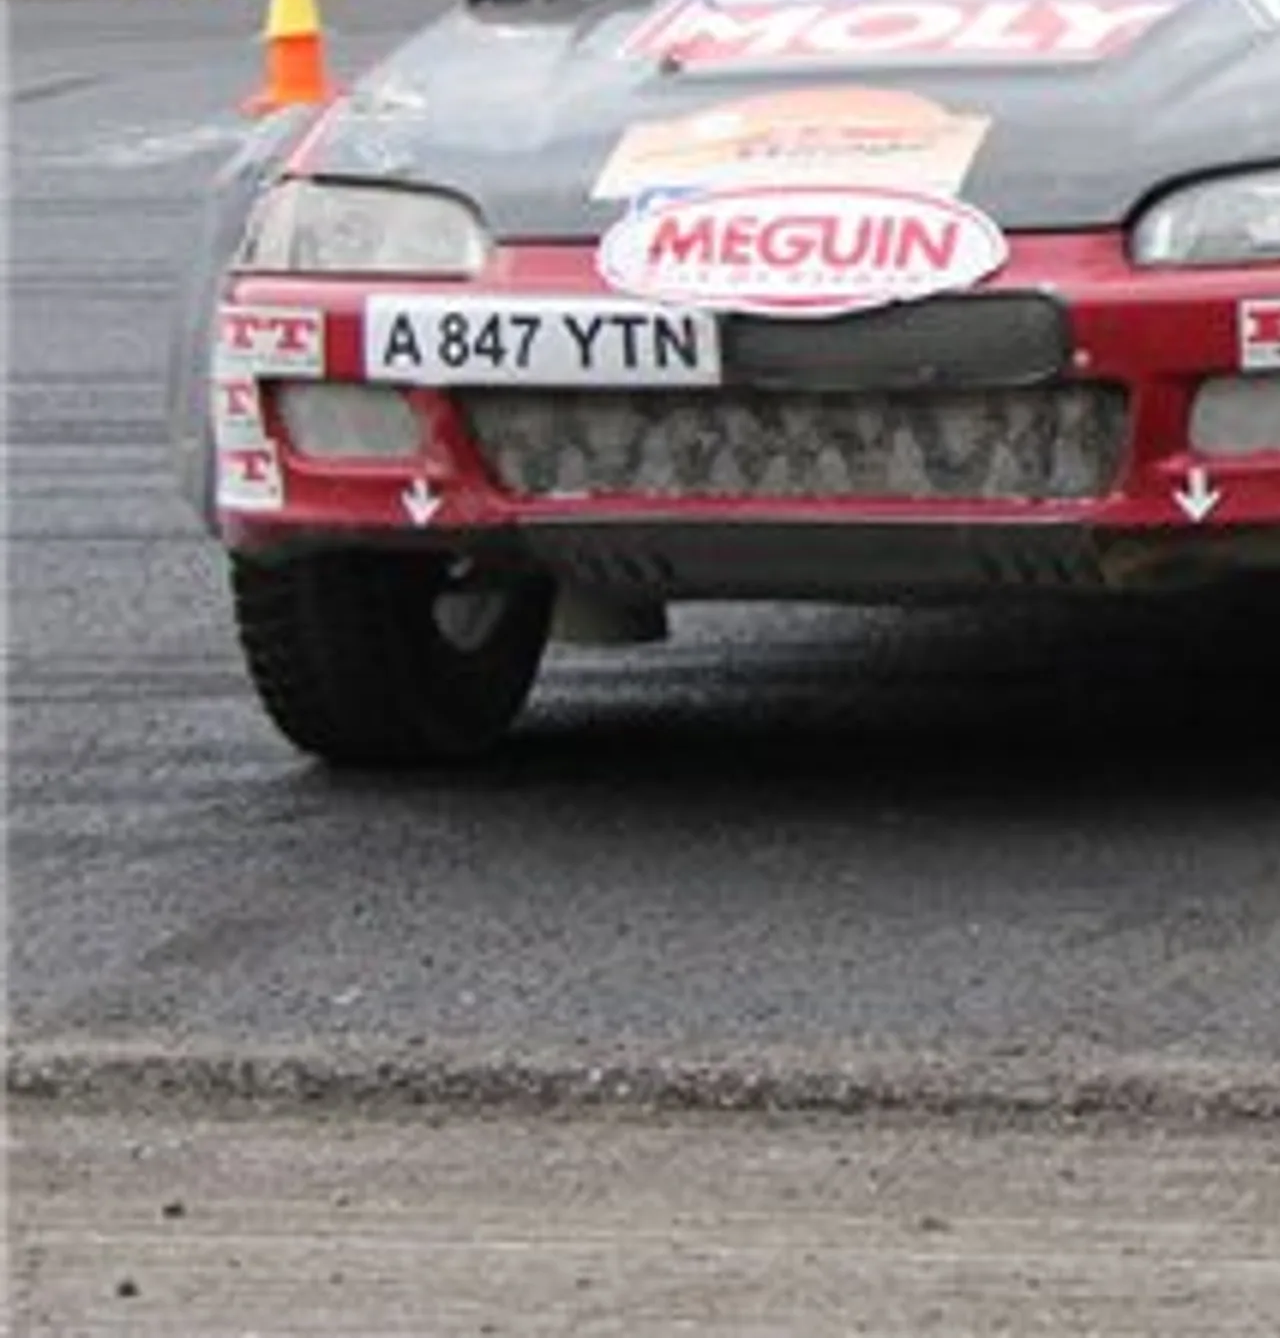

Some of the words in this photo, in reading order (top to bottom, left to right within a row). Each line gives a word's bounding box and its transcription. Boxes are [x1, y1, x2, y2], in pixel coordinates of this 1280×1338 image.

[657, 0, 1178, 56] MOLY
[648, 214, 962, 271] MEGUIN
[384, 314, 422, 366] A
[438, 312, 541, 368] 847
[571, 312, 699, 370] YTN
